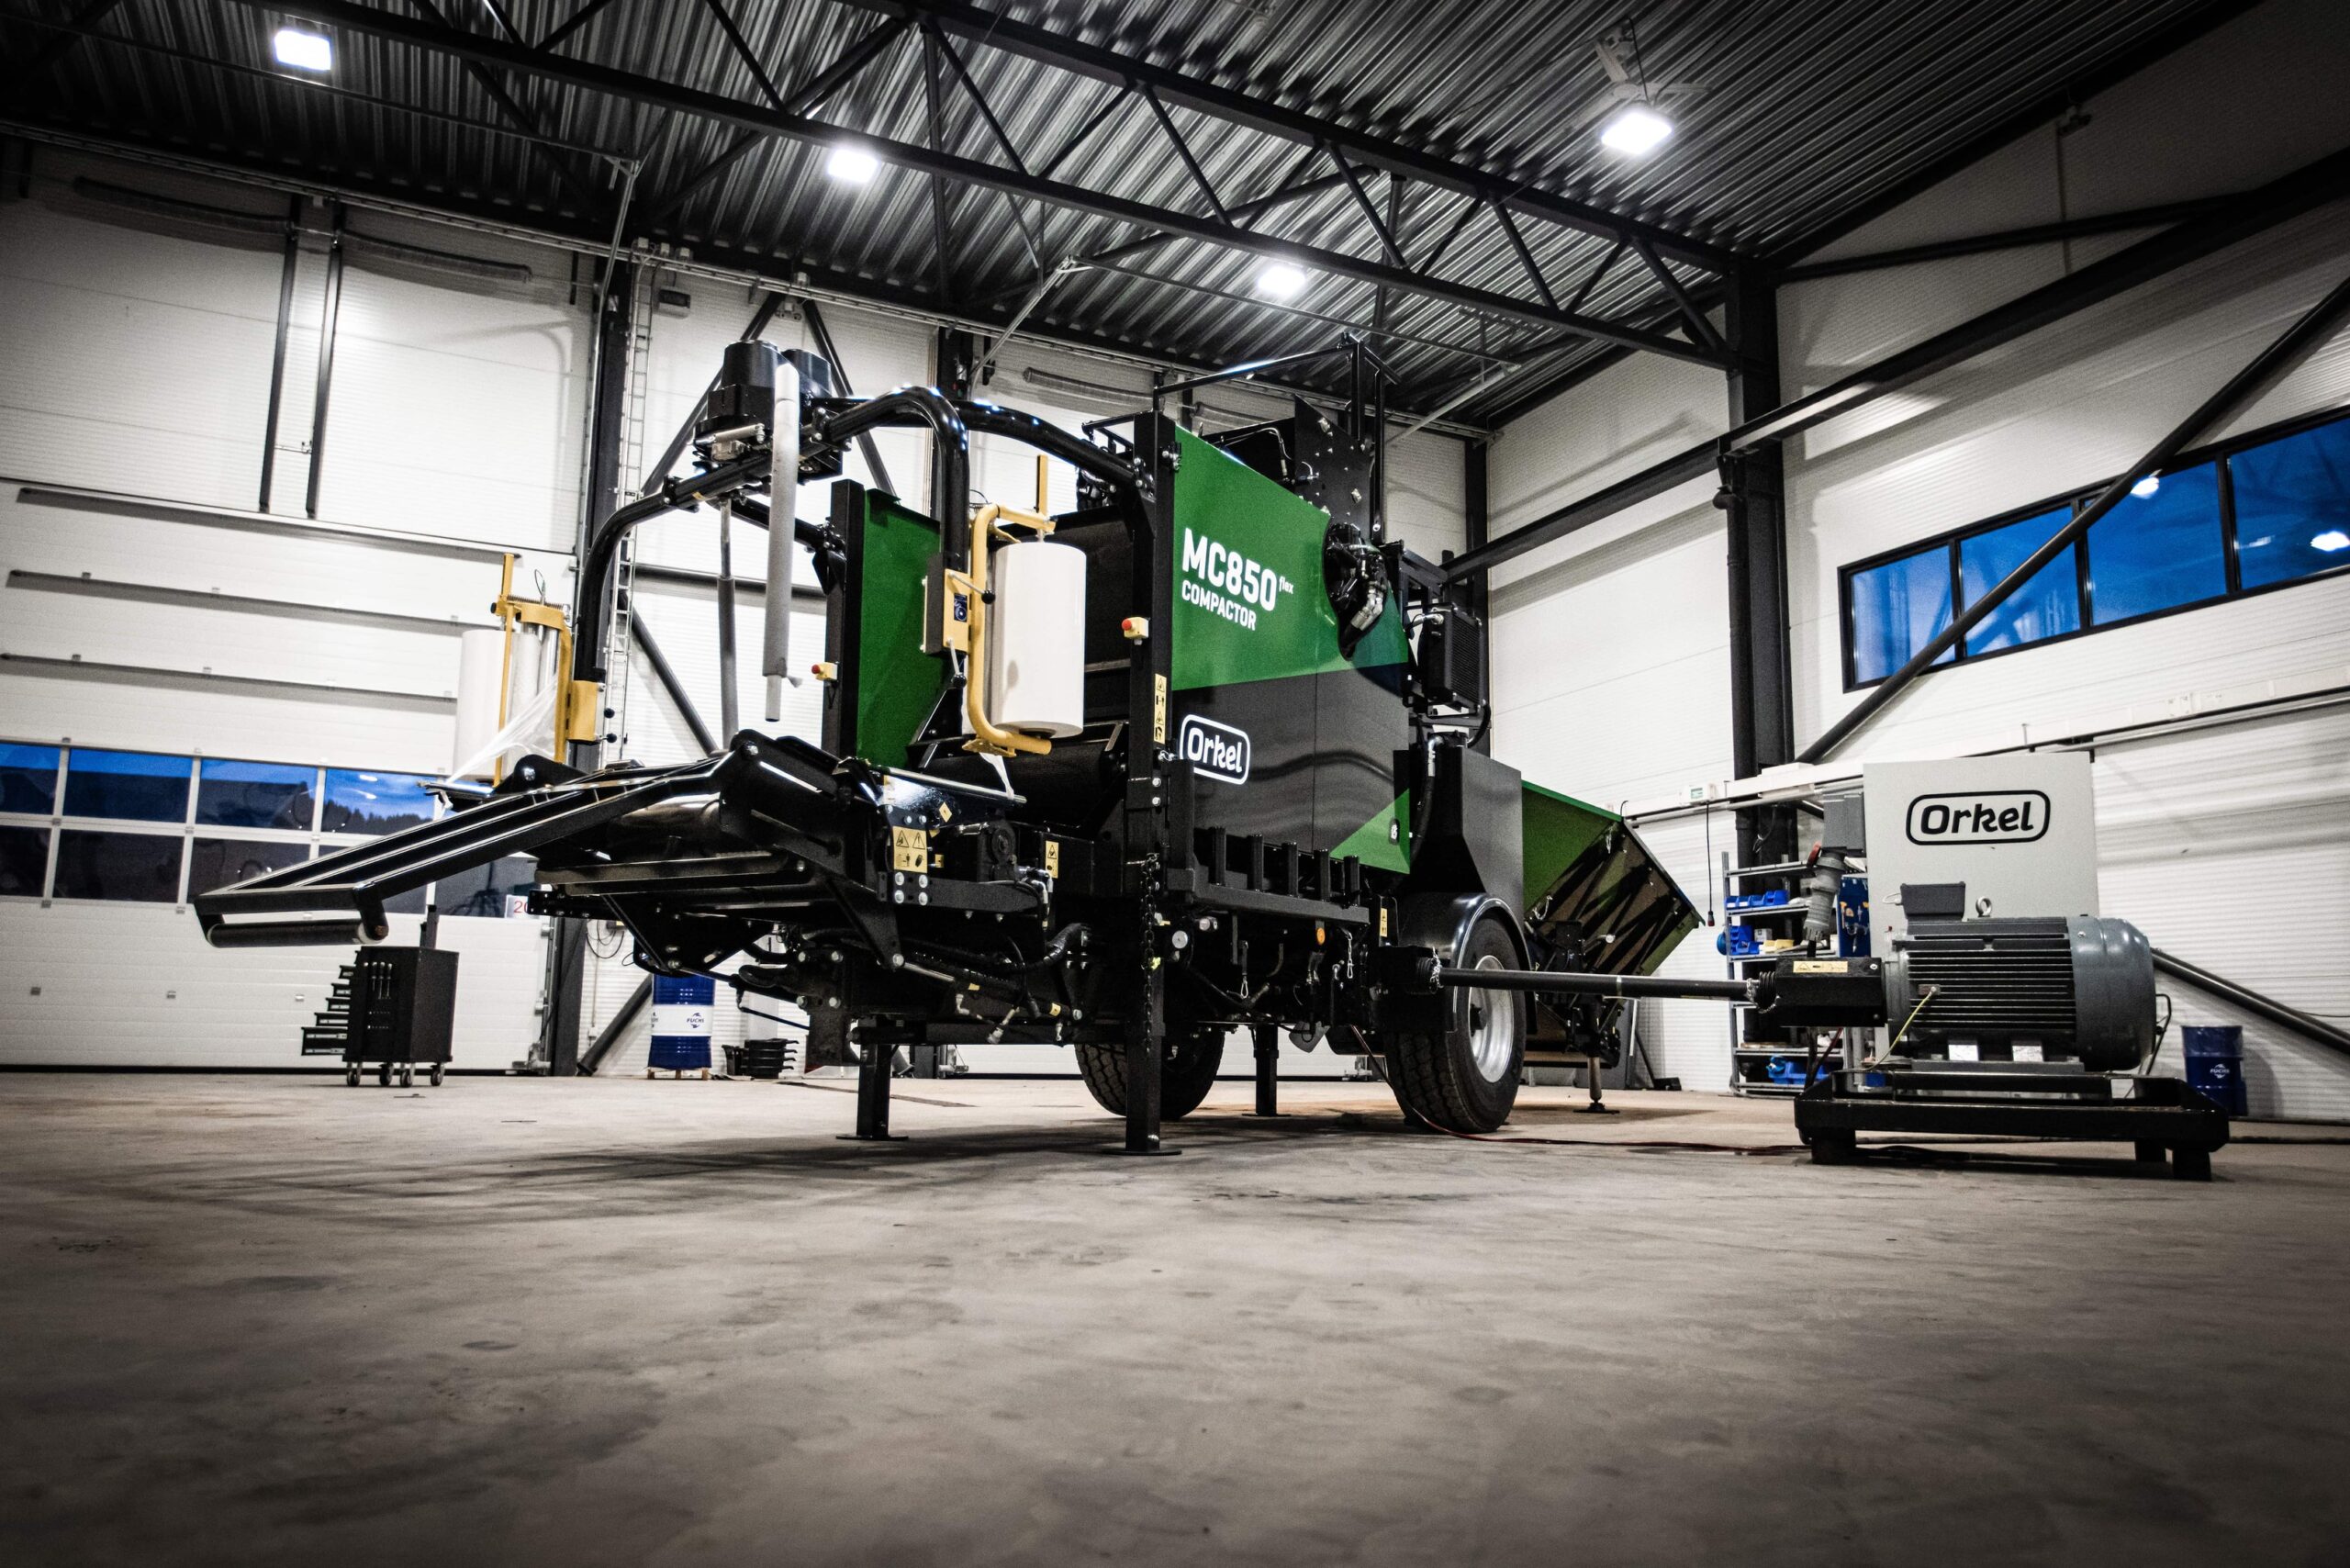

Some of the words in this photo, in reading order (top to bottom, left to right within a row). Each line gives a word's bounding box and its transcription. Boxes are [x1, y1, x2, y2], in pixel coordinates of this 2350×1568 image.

[1182, 527, 1277, 611] MC850
[1279, 576, 1293, 594] flex
[1181, 579, 1257, 631] COMPACTOR
[1188, 727, 1242, 773] Orkel
[1920, 801, 2034, 834] Orkel
